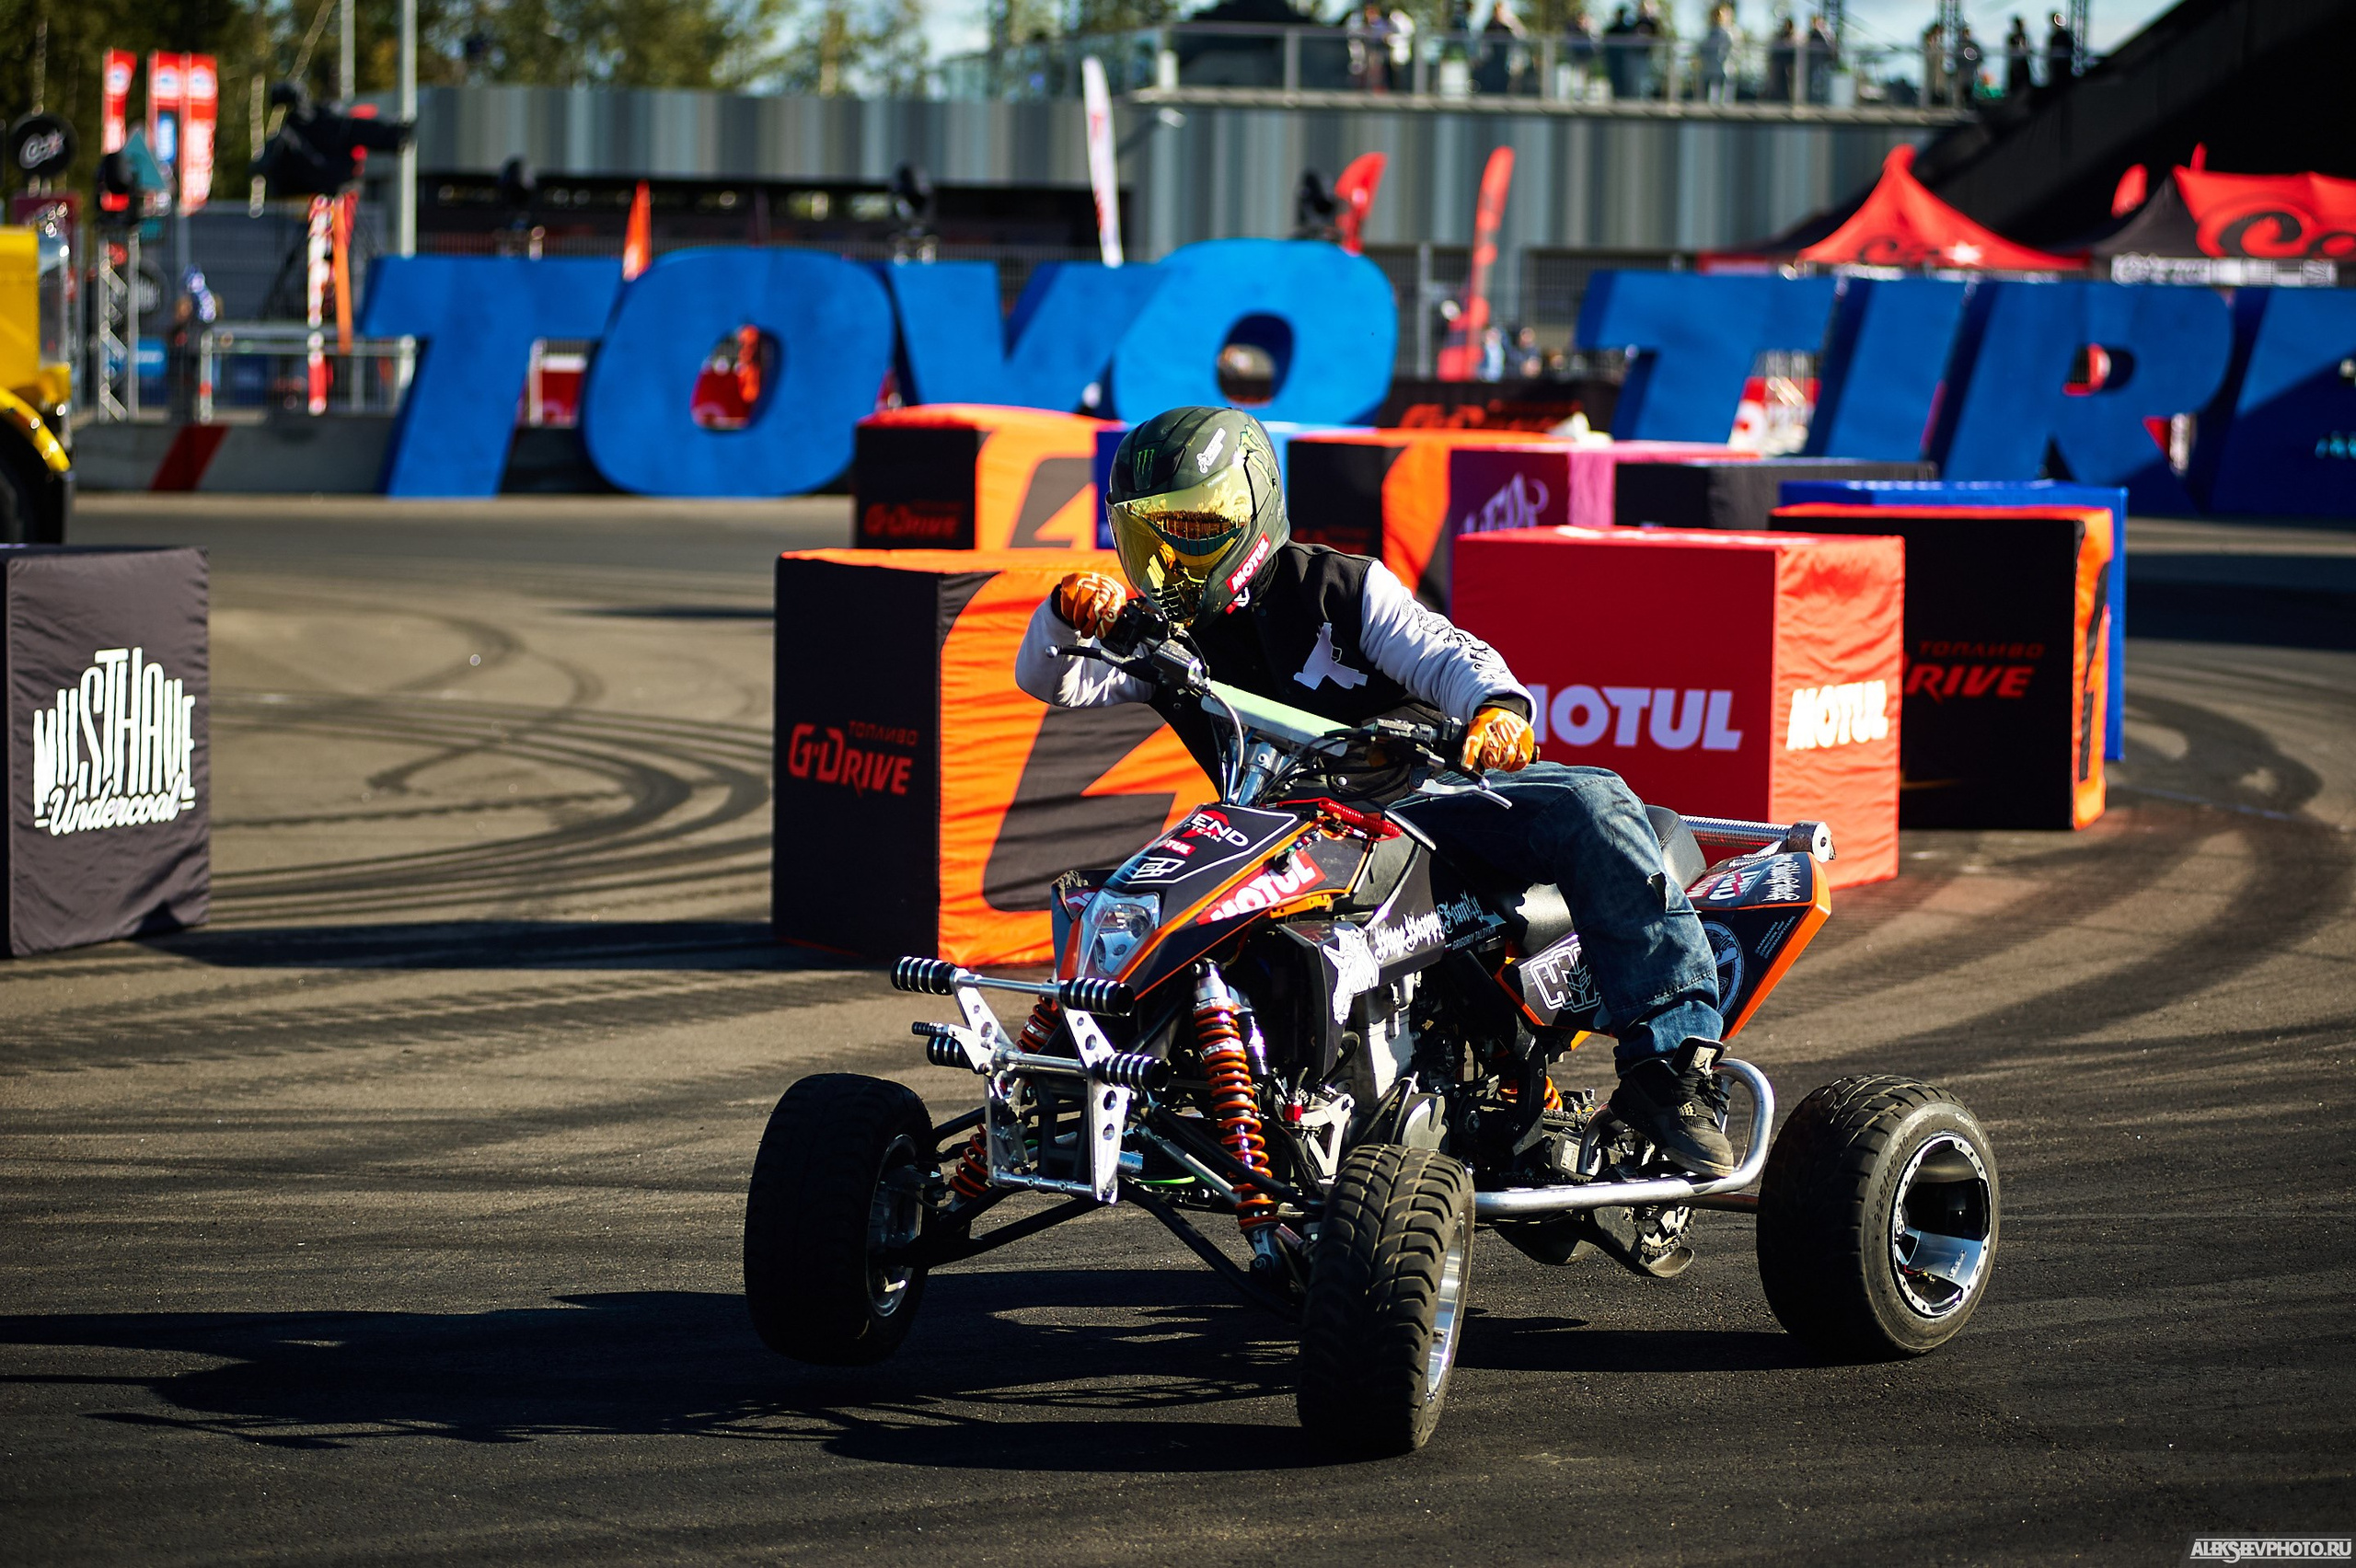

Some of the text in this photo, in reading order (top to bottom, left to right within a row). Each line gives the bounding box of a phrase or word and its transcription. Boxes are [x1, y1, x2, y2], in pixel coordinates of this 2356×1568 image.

[355, 238, 1397, 499] TOYO
[1231, 536, 1271, 592] MOTUL
[849, 720, 918, 747] ТОПЛИВО
[1785, 679, 1889, 751] MOTUL
[1191, 824, 1222, 843] TEAM
[1209, 855, 1316, 921] MOTUL
